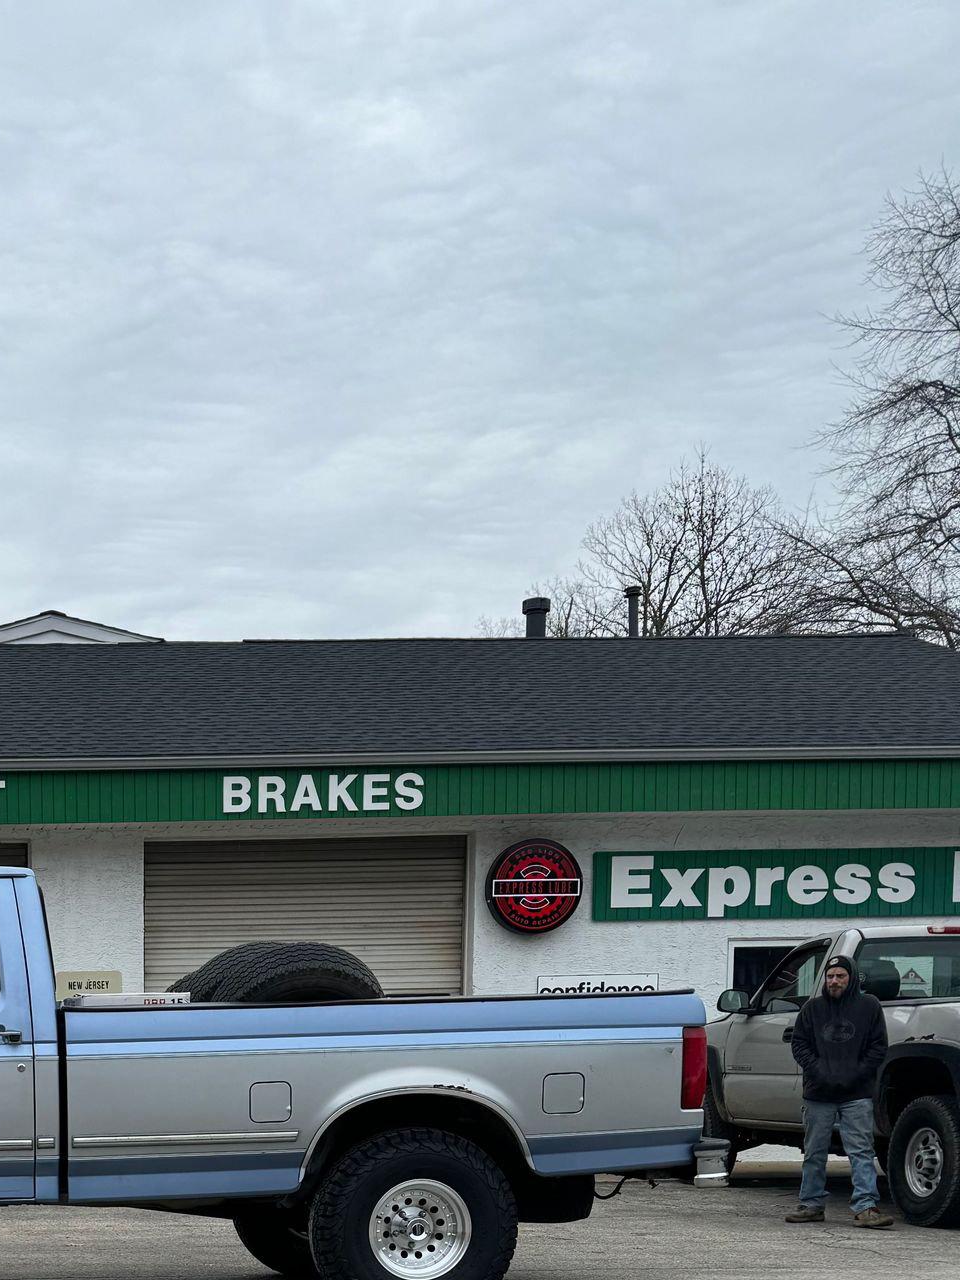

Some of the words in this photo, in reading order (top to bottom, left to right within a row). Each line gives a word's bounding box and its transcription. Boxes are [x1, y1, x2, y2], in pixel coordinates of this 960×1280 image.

[223, 772, 425, 813] BRAKES
[499, 882, 543, 894] EXPRESS
[548, 881, 572, 893] LUBE
[610, 855, 916, 918] Express
[510, 914, 529, 925] AUTO
[532, 913, 560, 926] REPAIR
[68, 981, 83, 990] NEW
[84, 980, 110, 990] JERSEY
